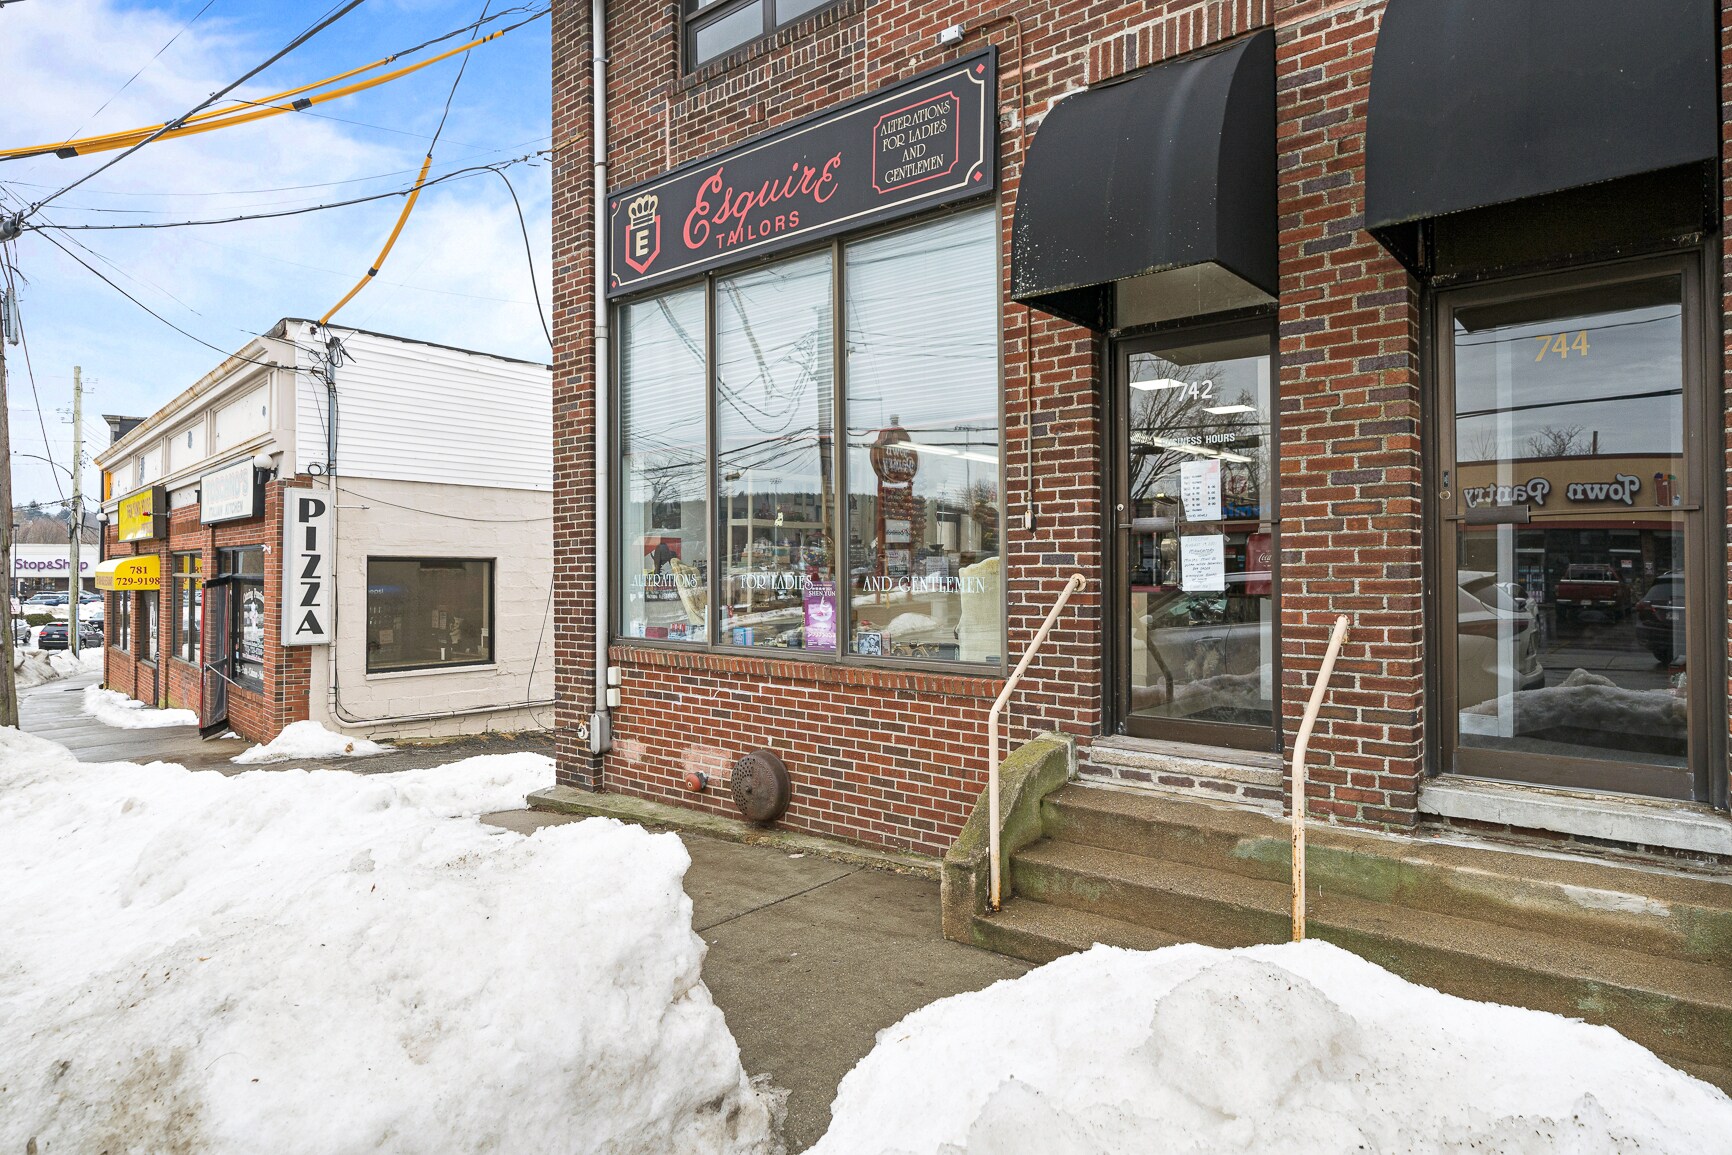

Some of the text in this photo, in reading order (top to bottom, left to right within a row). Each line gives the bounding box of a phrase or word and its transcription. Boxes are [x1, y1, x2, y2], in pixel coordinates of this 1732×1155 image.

[880, 100, 951, 136] ALTERATIONS
[882, 119, 948, 152] FOR LADIES
[902, 143, 926, 162] AND
[884, 154, 944, 183] GENTLEMEN
[716, 210, 800, 249] TAILORS
[635, 229, 650, 257] E
[1535, 329, 1590, 362] 744
[1179, 380, 1213, 401] 742
[1164, 433, 1236, 447] SINESS HOURS
[15, 558, 89, 572] Stop&Shp
[129, 566, 148, 575] 781
[296, 498, 326, 635] PIZZA
[116, 577, 161, 586] 729-9198
[631, 573, 698, 588] ALTERATIONS
[740, 574, 767, 589] FOR
[771, 574, 814, 590] LADIES
[862, 575, 893, 592] AND
[898, 576, 986, 594] GENTLEMEN
